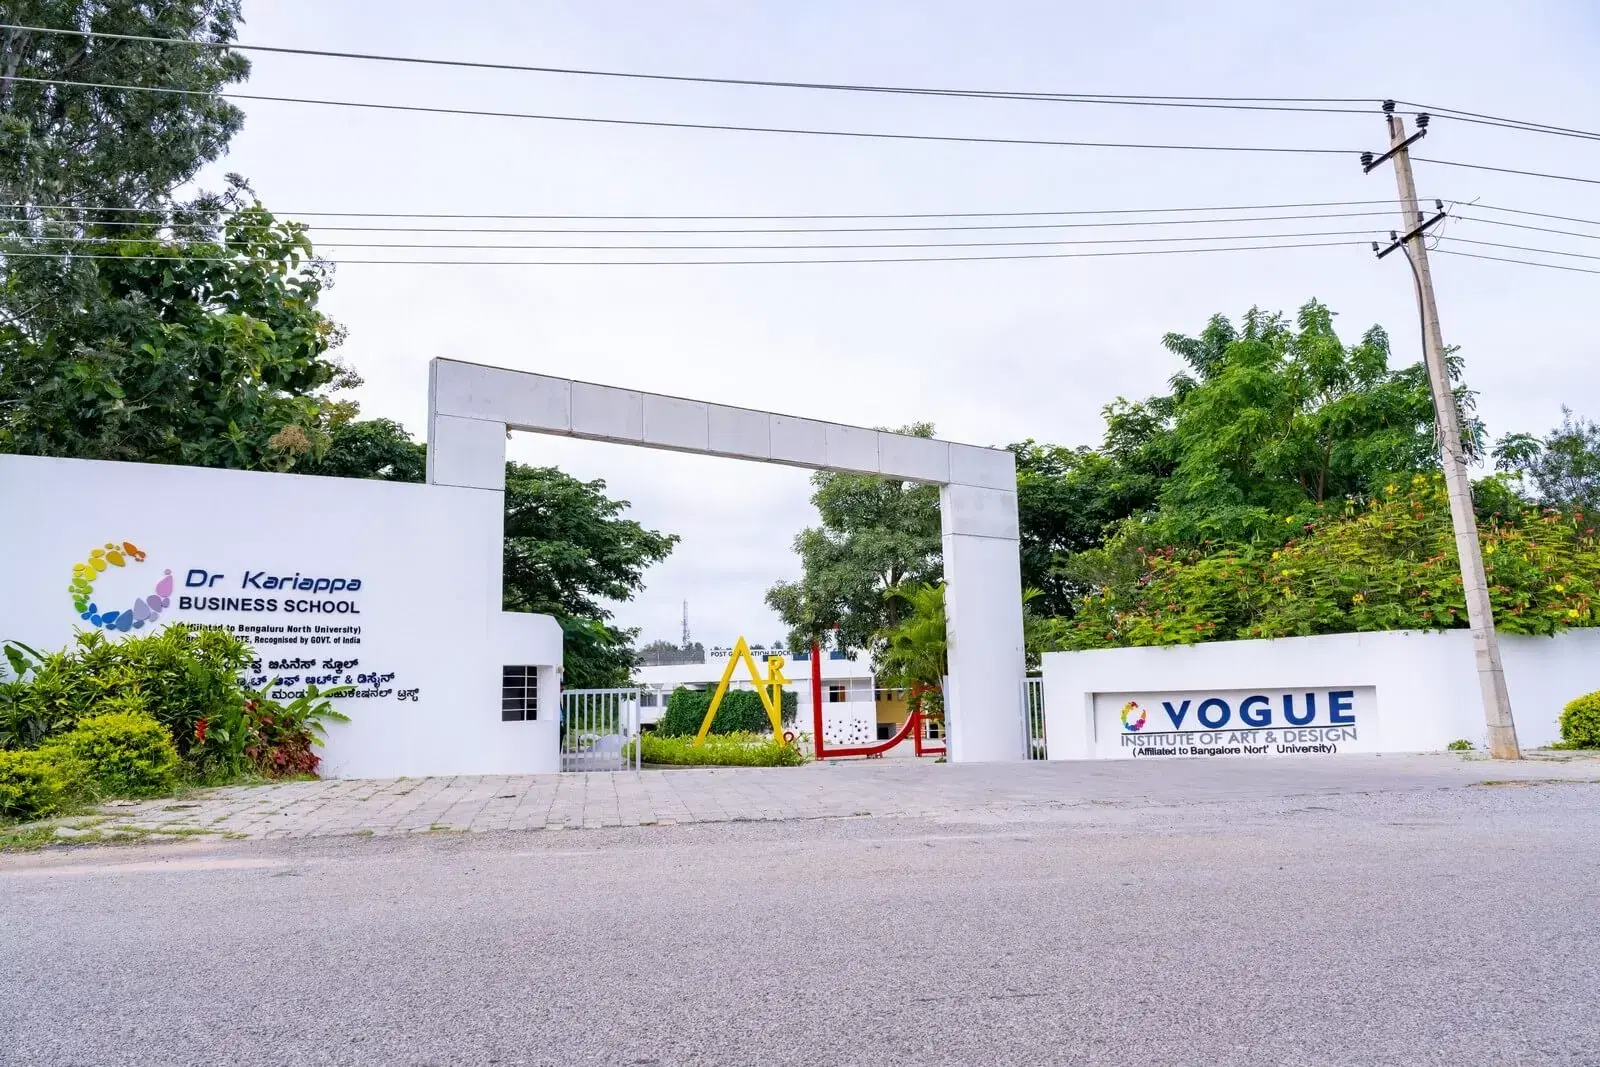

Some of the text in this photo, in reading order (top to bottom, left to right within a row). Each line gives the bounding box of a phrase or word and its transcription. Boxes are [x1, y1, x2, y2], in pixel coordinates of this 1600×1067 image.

[185, 569, 362, 594] Dr Kariappa
[179, 596, 361, 614] BUSINESS SCHOOL
[227, 624, 235, 632] to
[238, 624, 284, 634] Bengaluru
[287, 625, 312, 633] North
[315, 625, 361, 635] University)
[254, 635, 298, 646] Recognised
[300, 636, 309, 646] by
[311, 636, 331, 644] GOVT.
[333, 636, 341, 644] of
[343, 636, 361, 644] India
[345, 674, 353, 685] &
[1162, 690, 1356, 730] VOGUE
[1121, 727, 1358, 747] INSTITUTE OF ART & DESIGN
[1179, 747, 1188, 755] to
[1190, 746, 1241, 756] Bangalore
[1276, 743, 1337, 754] University)
